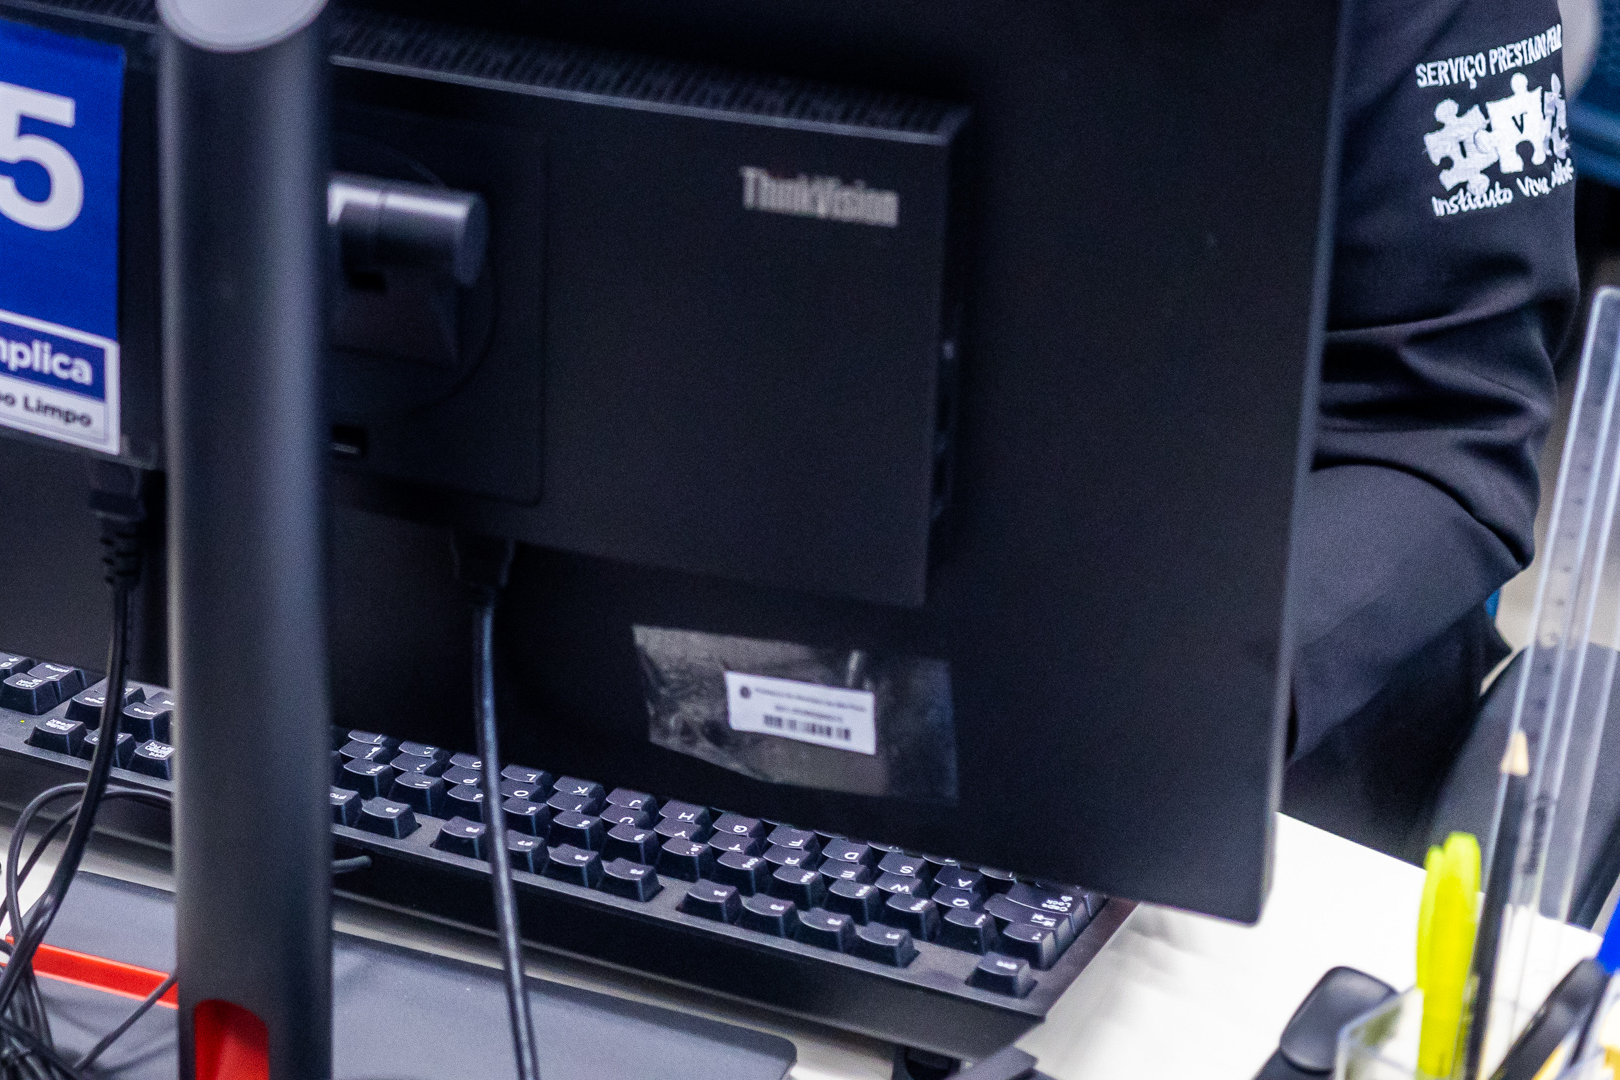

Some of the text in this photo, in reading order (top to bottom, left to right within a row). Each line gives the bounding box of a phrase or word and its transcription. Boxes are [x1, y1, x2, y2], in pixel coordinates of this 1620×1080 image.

[1416, 52, 1487, 90] SERVIÇO
[1431, 181, 1513, 217] Instituto
[23, 396, 93, 428] Limpo
